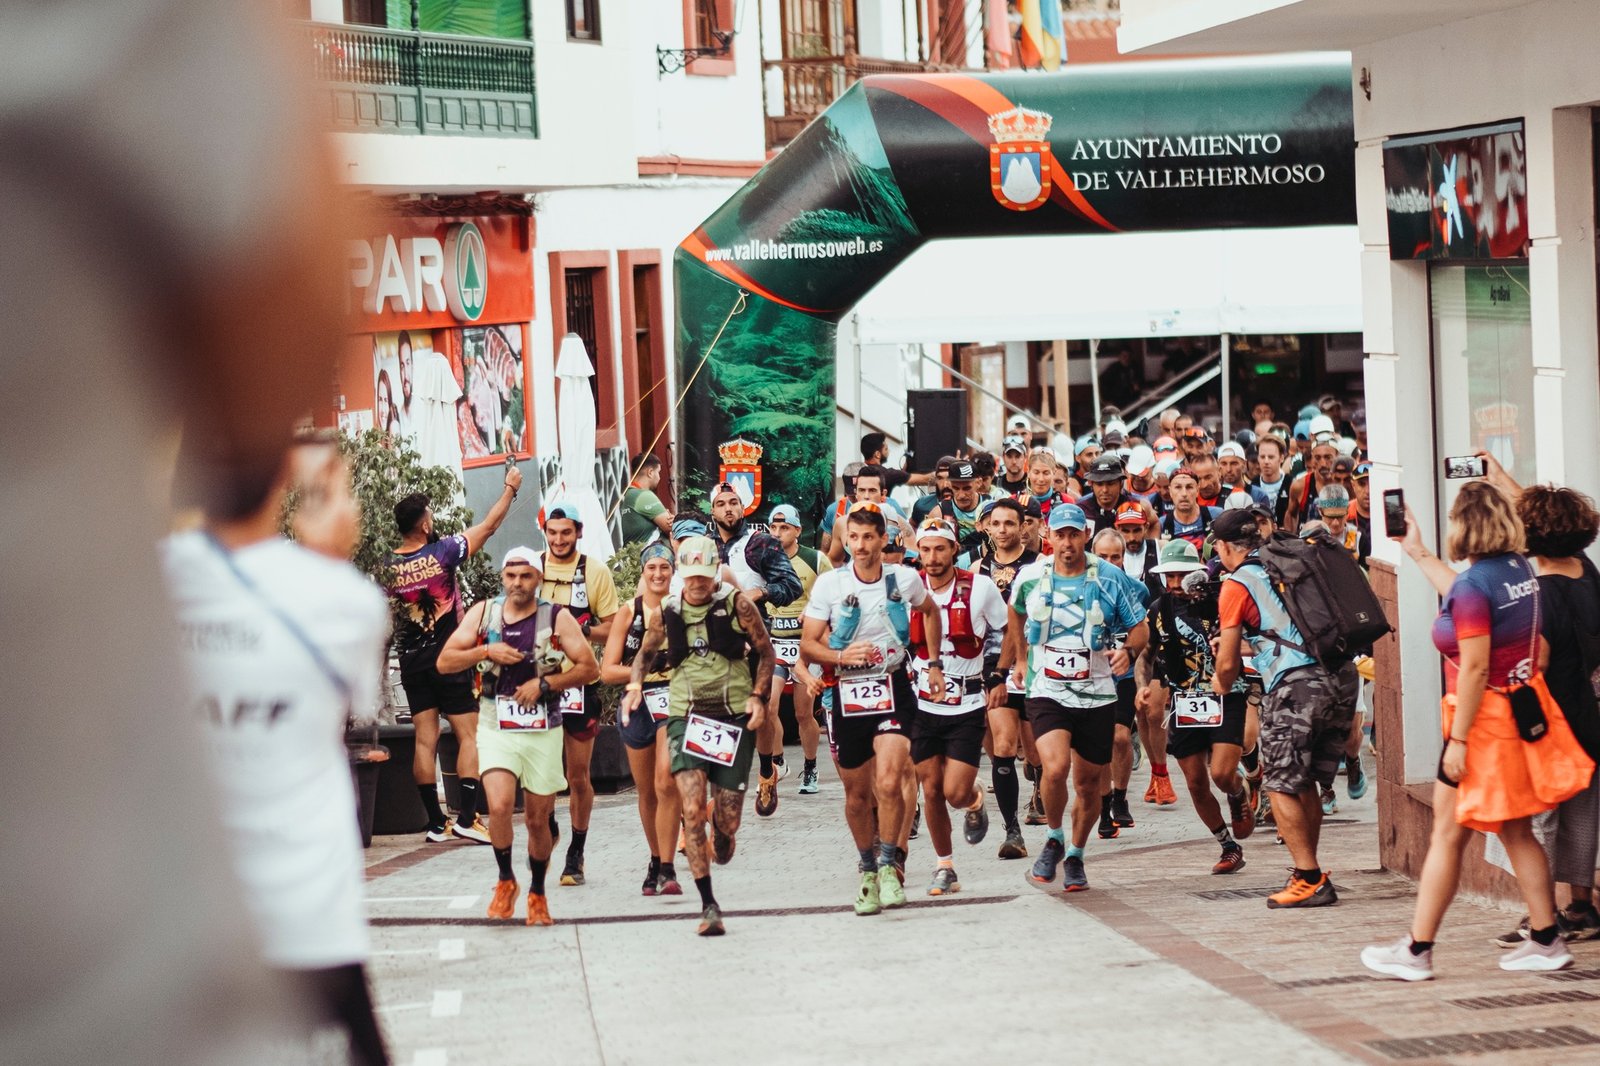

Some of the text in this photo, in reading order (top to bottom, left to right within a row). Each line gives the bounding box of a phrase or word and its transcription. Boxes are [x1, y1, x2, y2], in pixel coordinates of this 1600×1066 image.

[1071, 133, 1282, 161] AYUNTAMIENTO
[1072, 163, 1326, 191] DE VALLEHERMOSO
[705, 236, 883, 262] www.vallehermosoweb.es
[344, 233, 447, 314] PAR
[391, 554, 438, 576] OMERA
[391, 563, 443, 589] ARADISE
[781, 646, 798, 657] 20
[1055, 656, 1076, 668] 41
[850, 685, 882, 699] 125
[945, 682, 955, 693] 2
[507, 703, 538, 716] 108
[658, 696, 668, 708] 3
[1189, 700, 1208, 713] 31
[702, 729, 722, 746] 51
